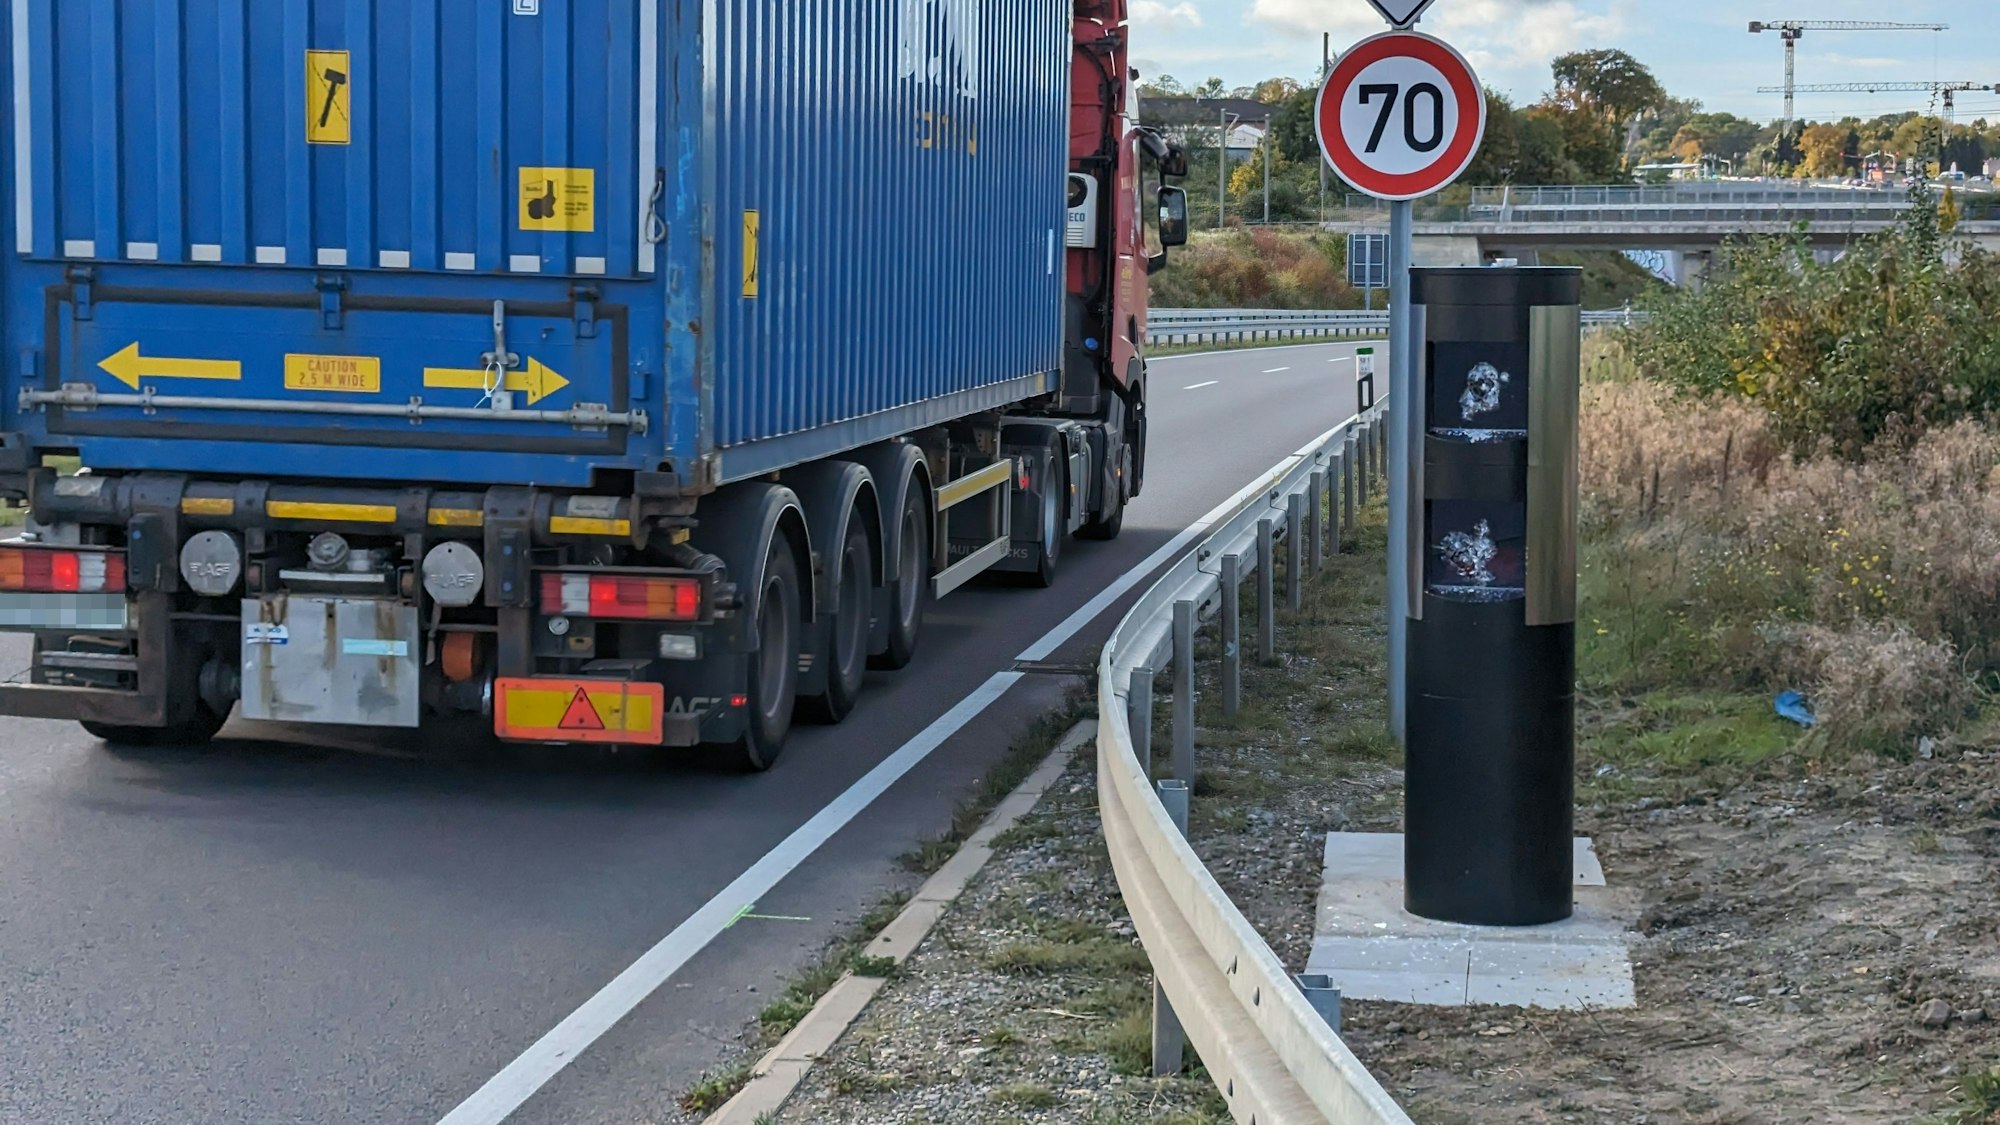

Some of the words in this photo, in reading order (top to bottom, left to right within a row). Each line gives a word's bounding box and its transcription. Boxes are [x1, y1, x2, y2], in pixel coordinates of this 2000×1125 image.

[1358, 82, 1444, 153] 70
[1068, 213, 1086, 222] ECO
[308, 359, 357, 373] CAUTION
[323, 373, 332, 385] M
[338, 374, 366, 387] WIDE
